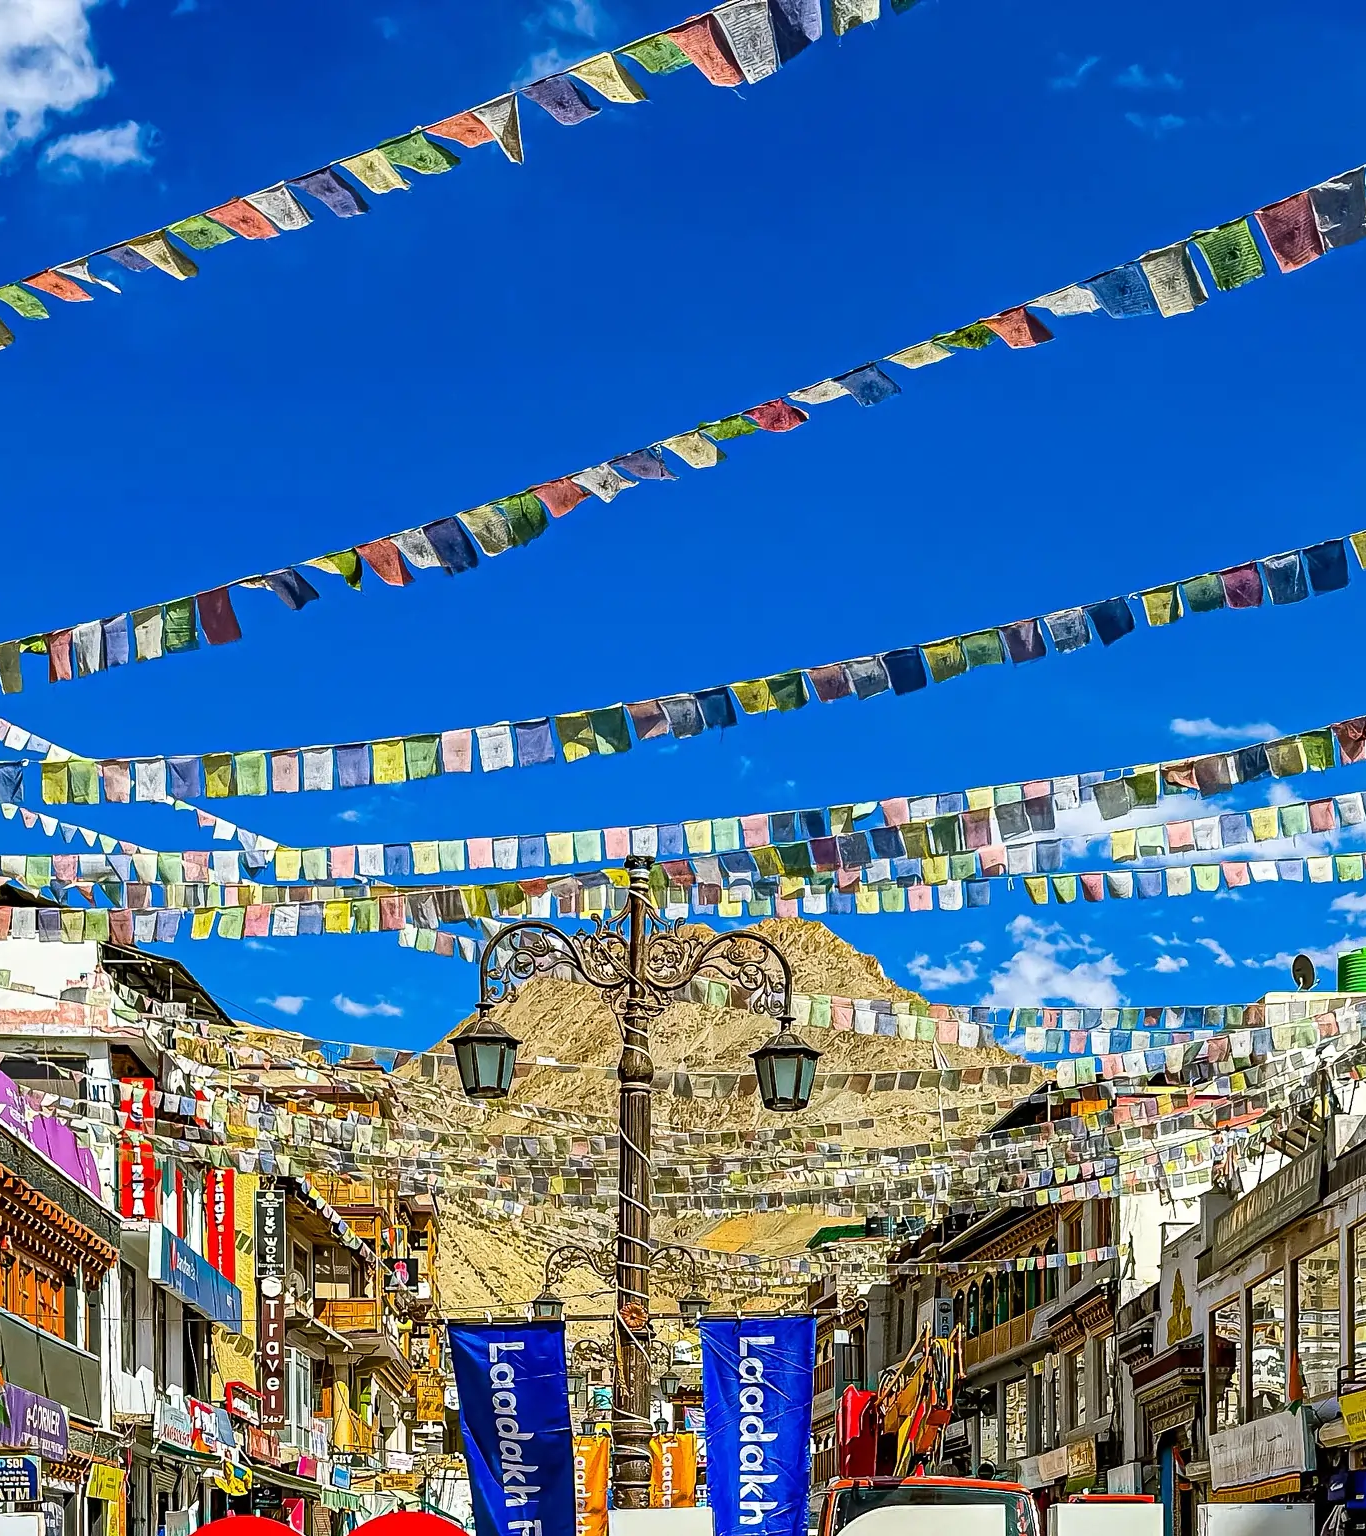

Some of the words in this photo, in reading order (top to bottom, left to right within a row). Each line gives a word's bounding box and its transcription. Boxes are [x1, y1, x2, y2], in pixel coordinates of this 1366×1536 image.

[265, 1300, 280, 1409] Travel
[6, 1458, 23, 1469] SBI
[263, 1415, 284, 1424] 24x7
[489, 1341, 542, 1508] Laadakh
[738, 1335, 779, 1525] Laadakh
